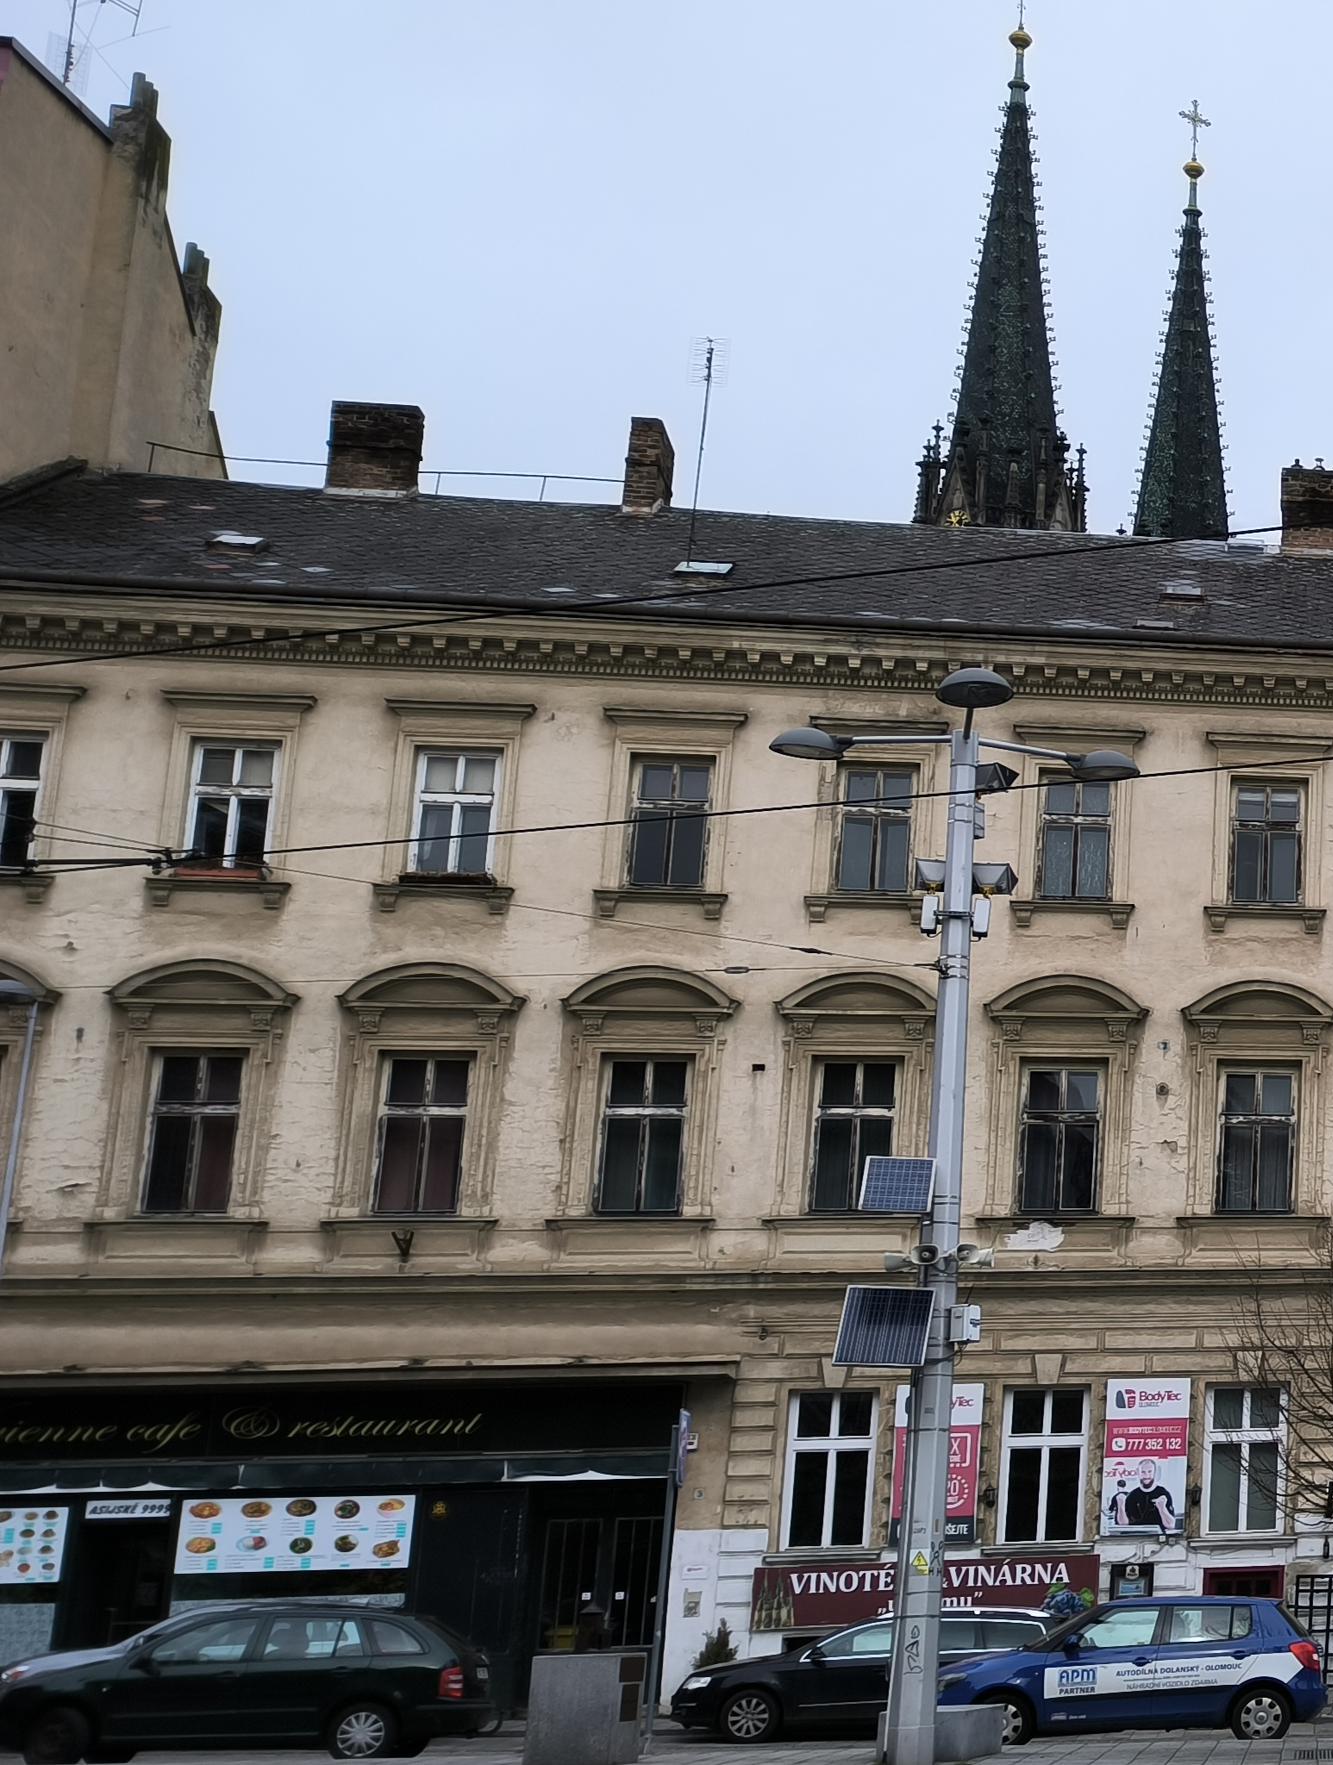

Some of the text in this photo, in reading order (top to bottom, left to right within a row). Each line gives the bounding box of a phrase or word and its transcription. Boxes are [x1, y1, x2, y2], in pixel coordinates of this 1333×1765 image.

[950, 1396, 974, 1409] yTec
[1139, 1390, 1182, 1403] BodyTec
[287, 1413, 482, 1438] restaurant
[1127, 1438, 1182, 1451] 777 352 132
[789, 1559, 1071, 1595] VINOTÉ VINÁRNA
[1205, 1663, 1243, 1672] OLOMOUC
[1059, 1669, 1097, 1684] APM
[1058, 1686, 1096, 1695] PARTNER
